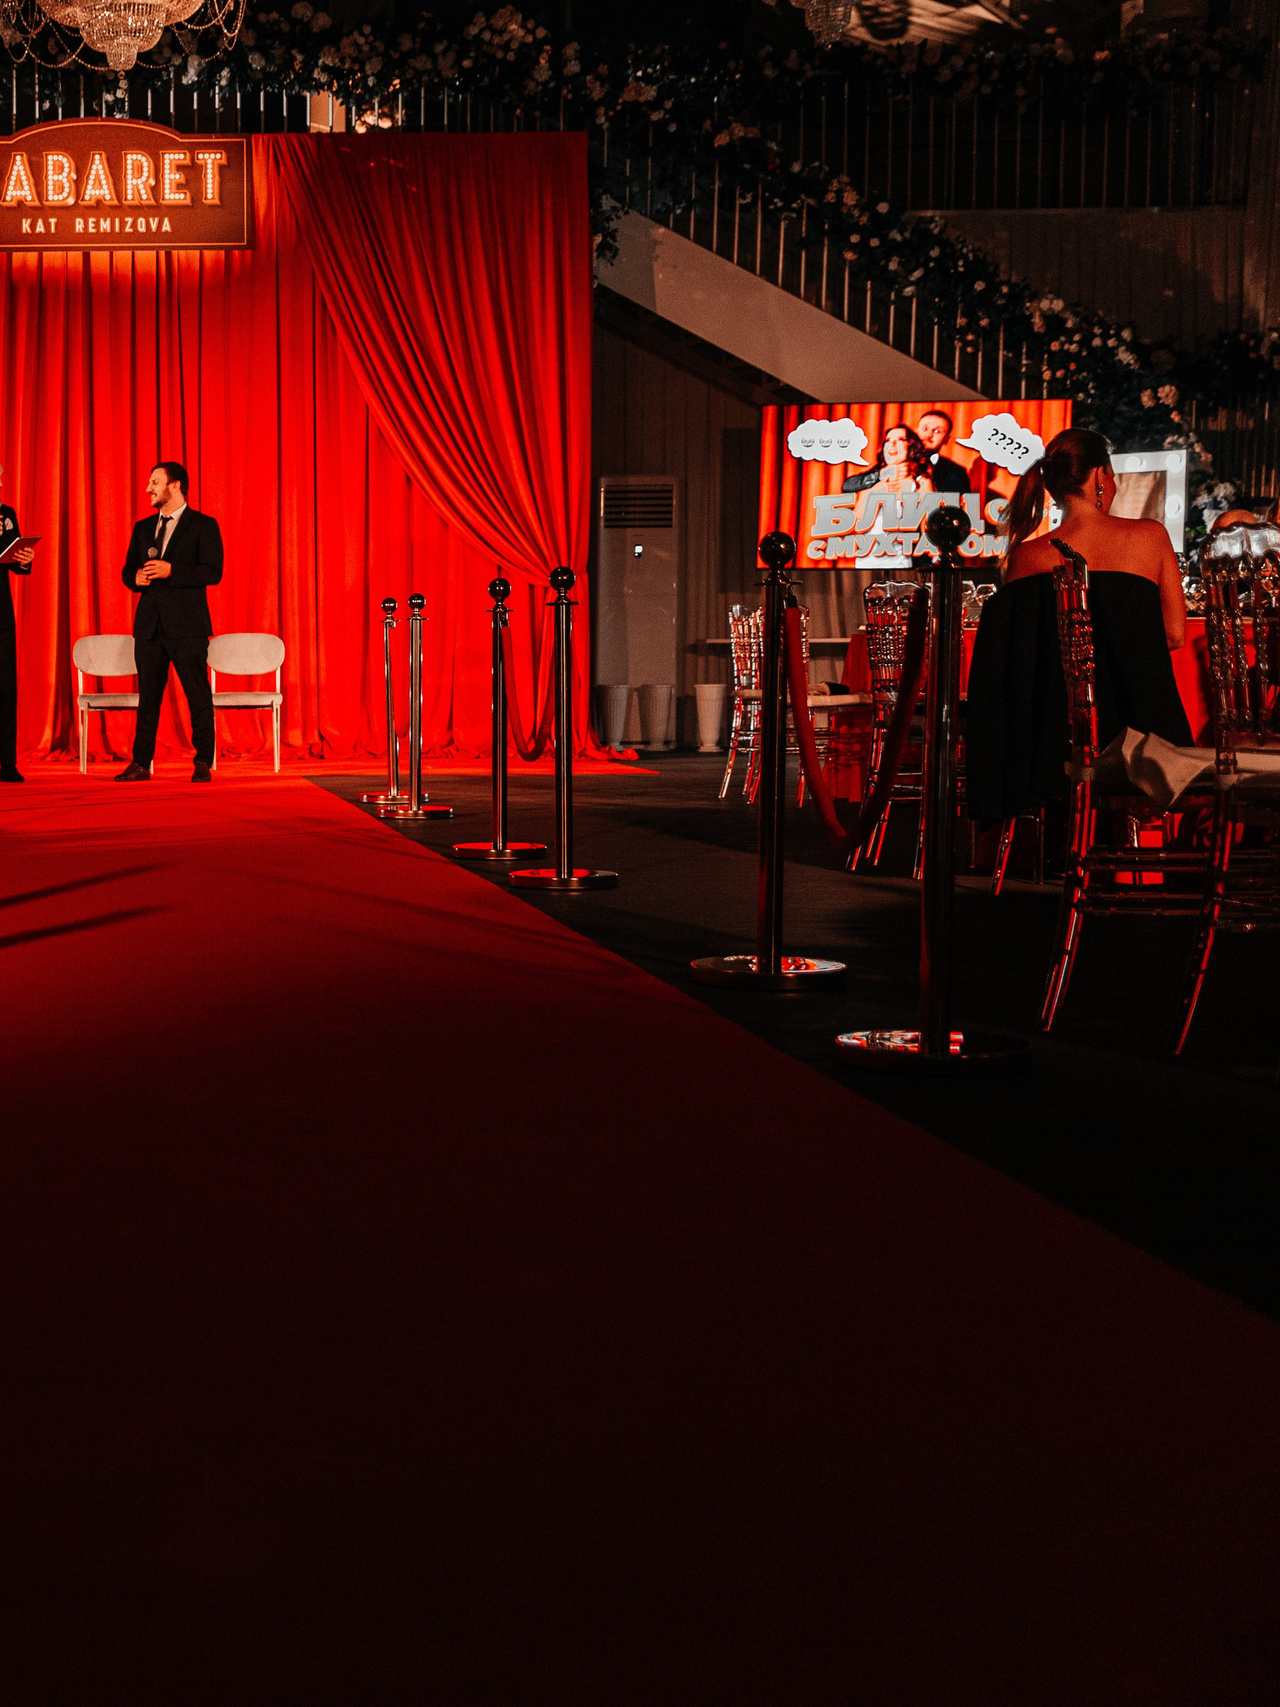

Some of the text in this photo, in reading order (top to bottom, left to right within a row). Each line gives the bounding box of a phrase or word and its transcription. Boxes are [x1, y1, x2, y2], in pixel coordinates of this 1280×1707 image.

[22, 217, 173, 234] KAT REMIZOVA
[825, 532, 1011, 560] МУХТАОМ
